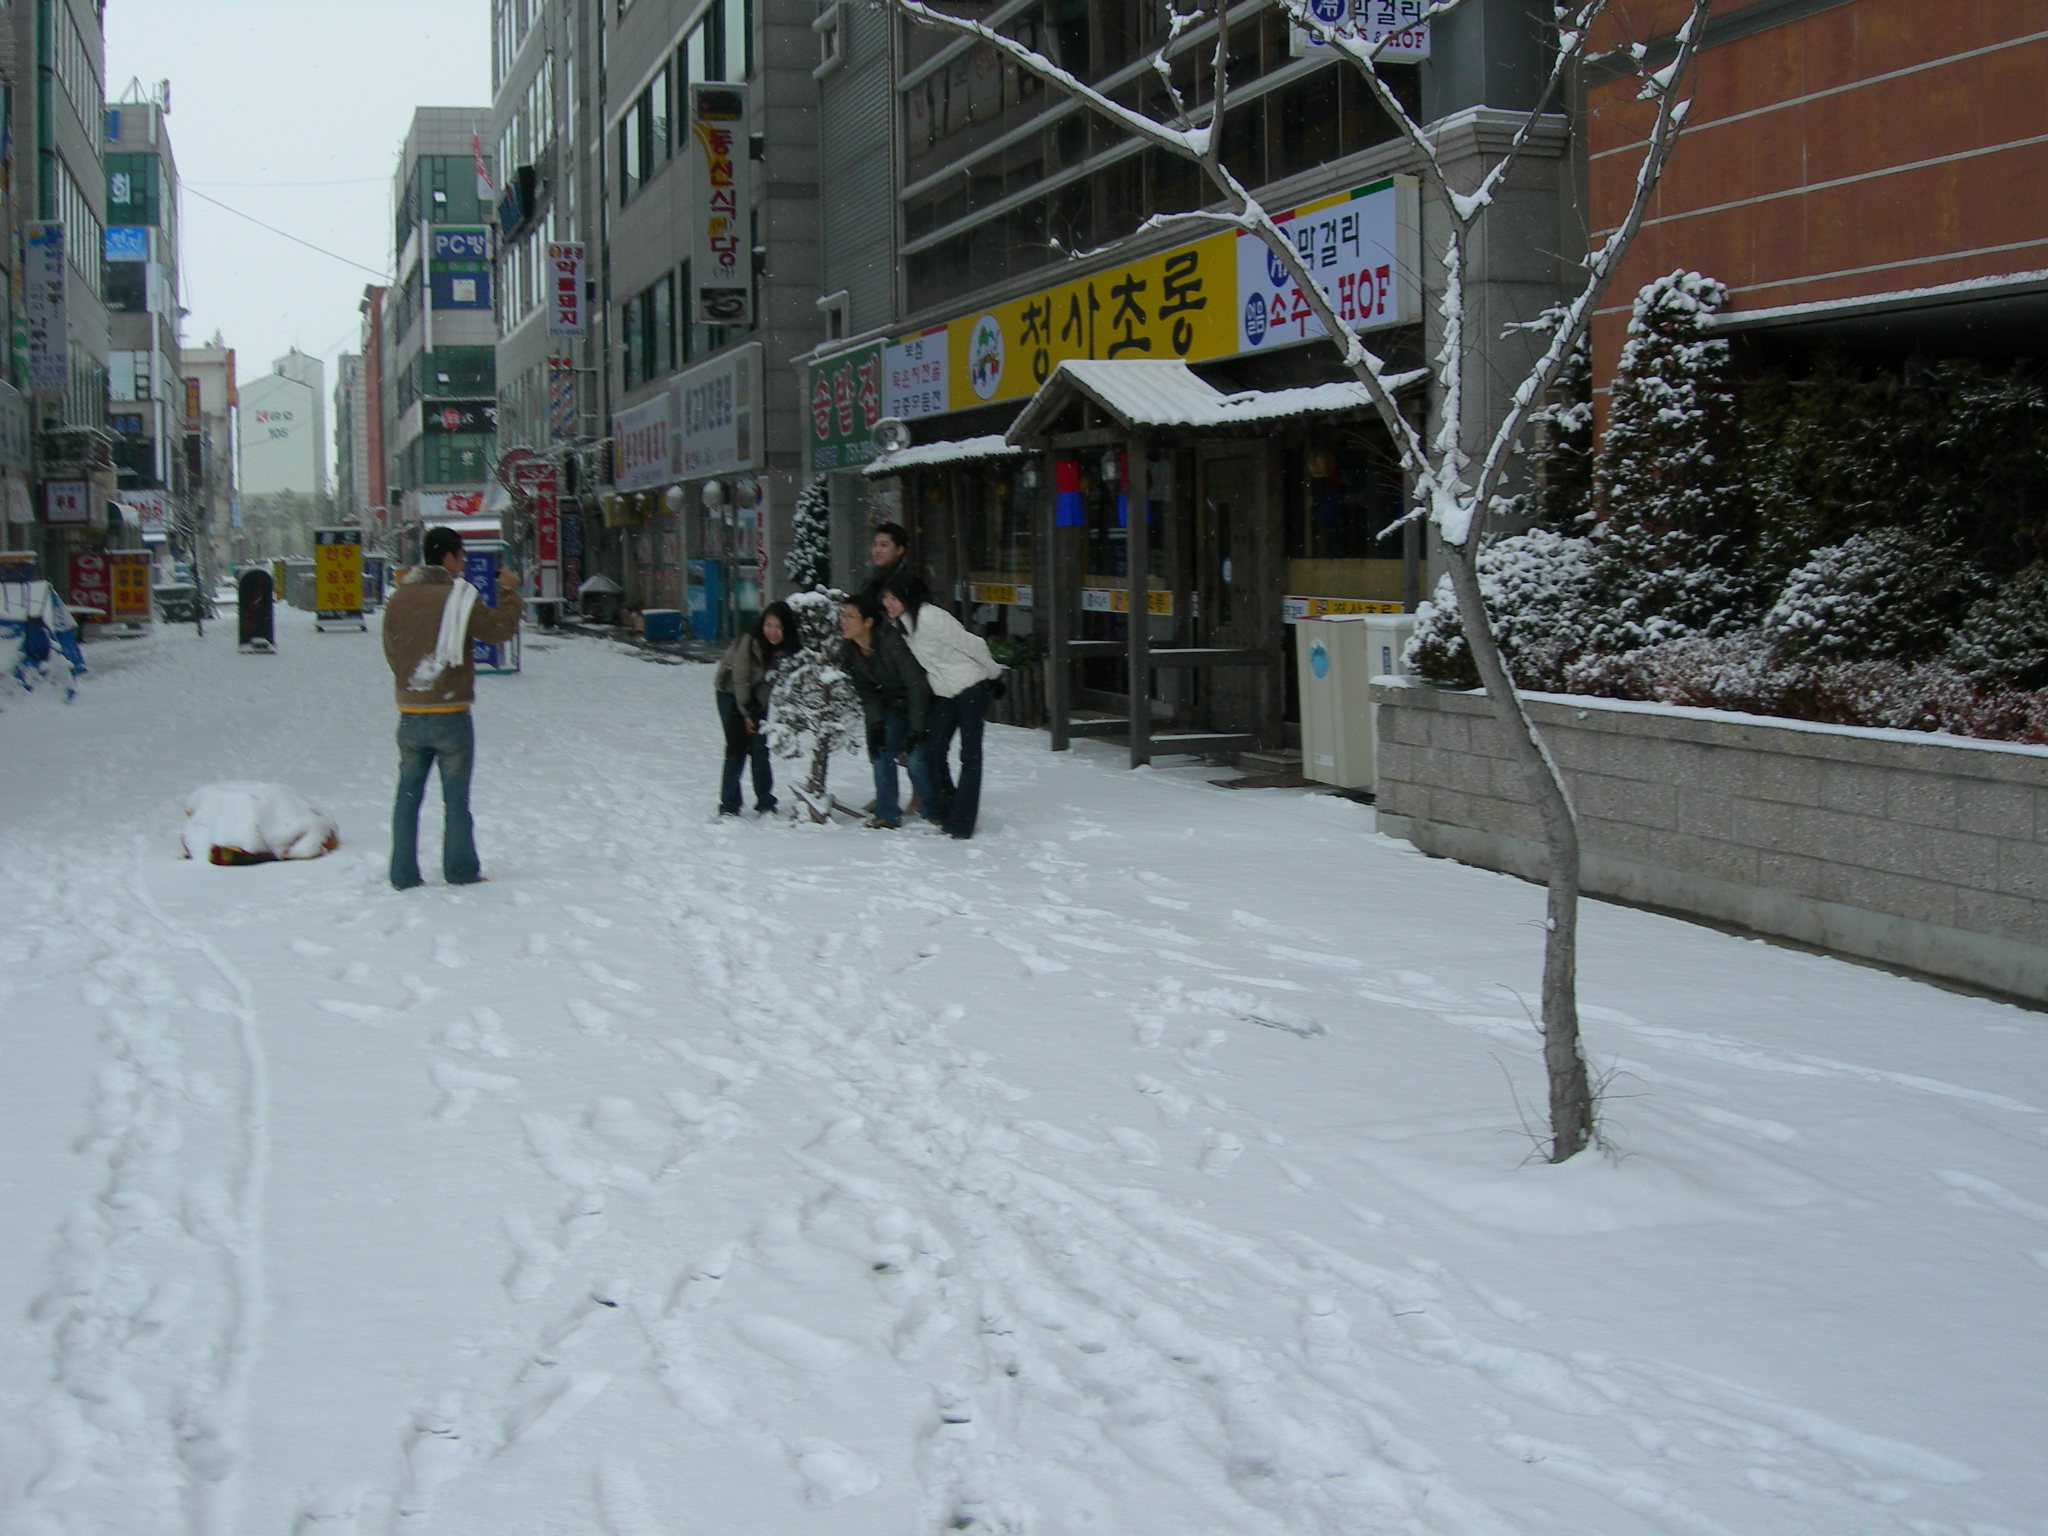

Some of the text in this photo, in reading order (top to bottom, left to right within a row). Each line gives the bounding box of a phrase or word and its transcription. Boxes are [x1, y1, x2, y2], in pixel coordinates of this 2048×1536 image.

[436, 234, 486, 255] PC방
[1299, 211, 1360, 271] 막걸리
[1020, 250, 1208, 386] 청사초롱
[1269, 285, 1313, 338] 소주
[1338, 264, 1391, 322] HOF
